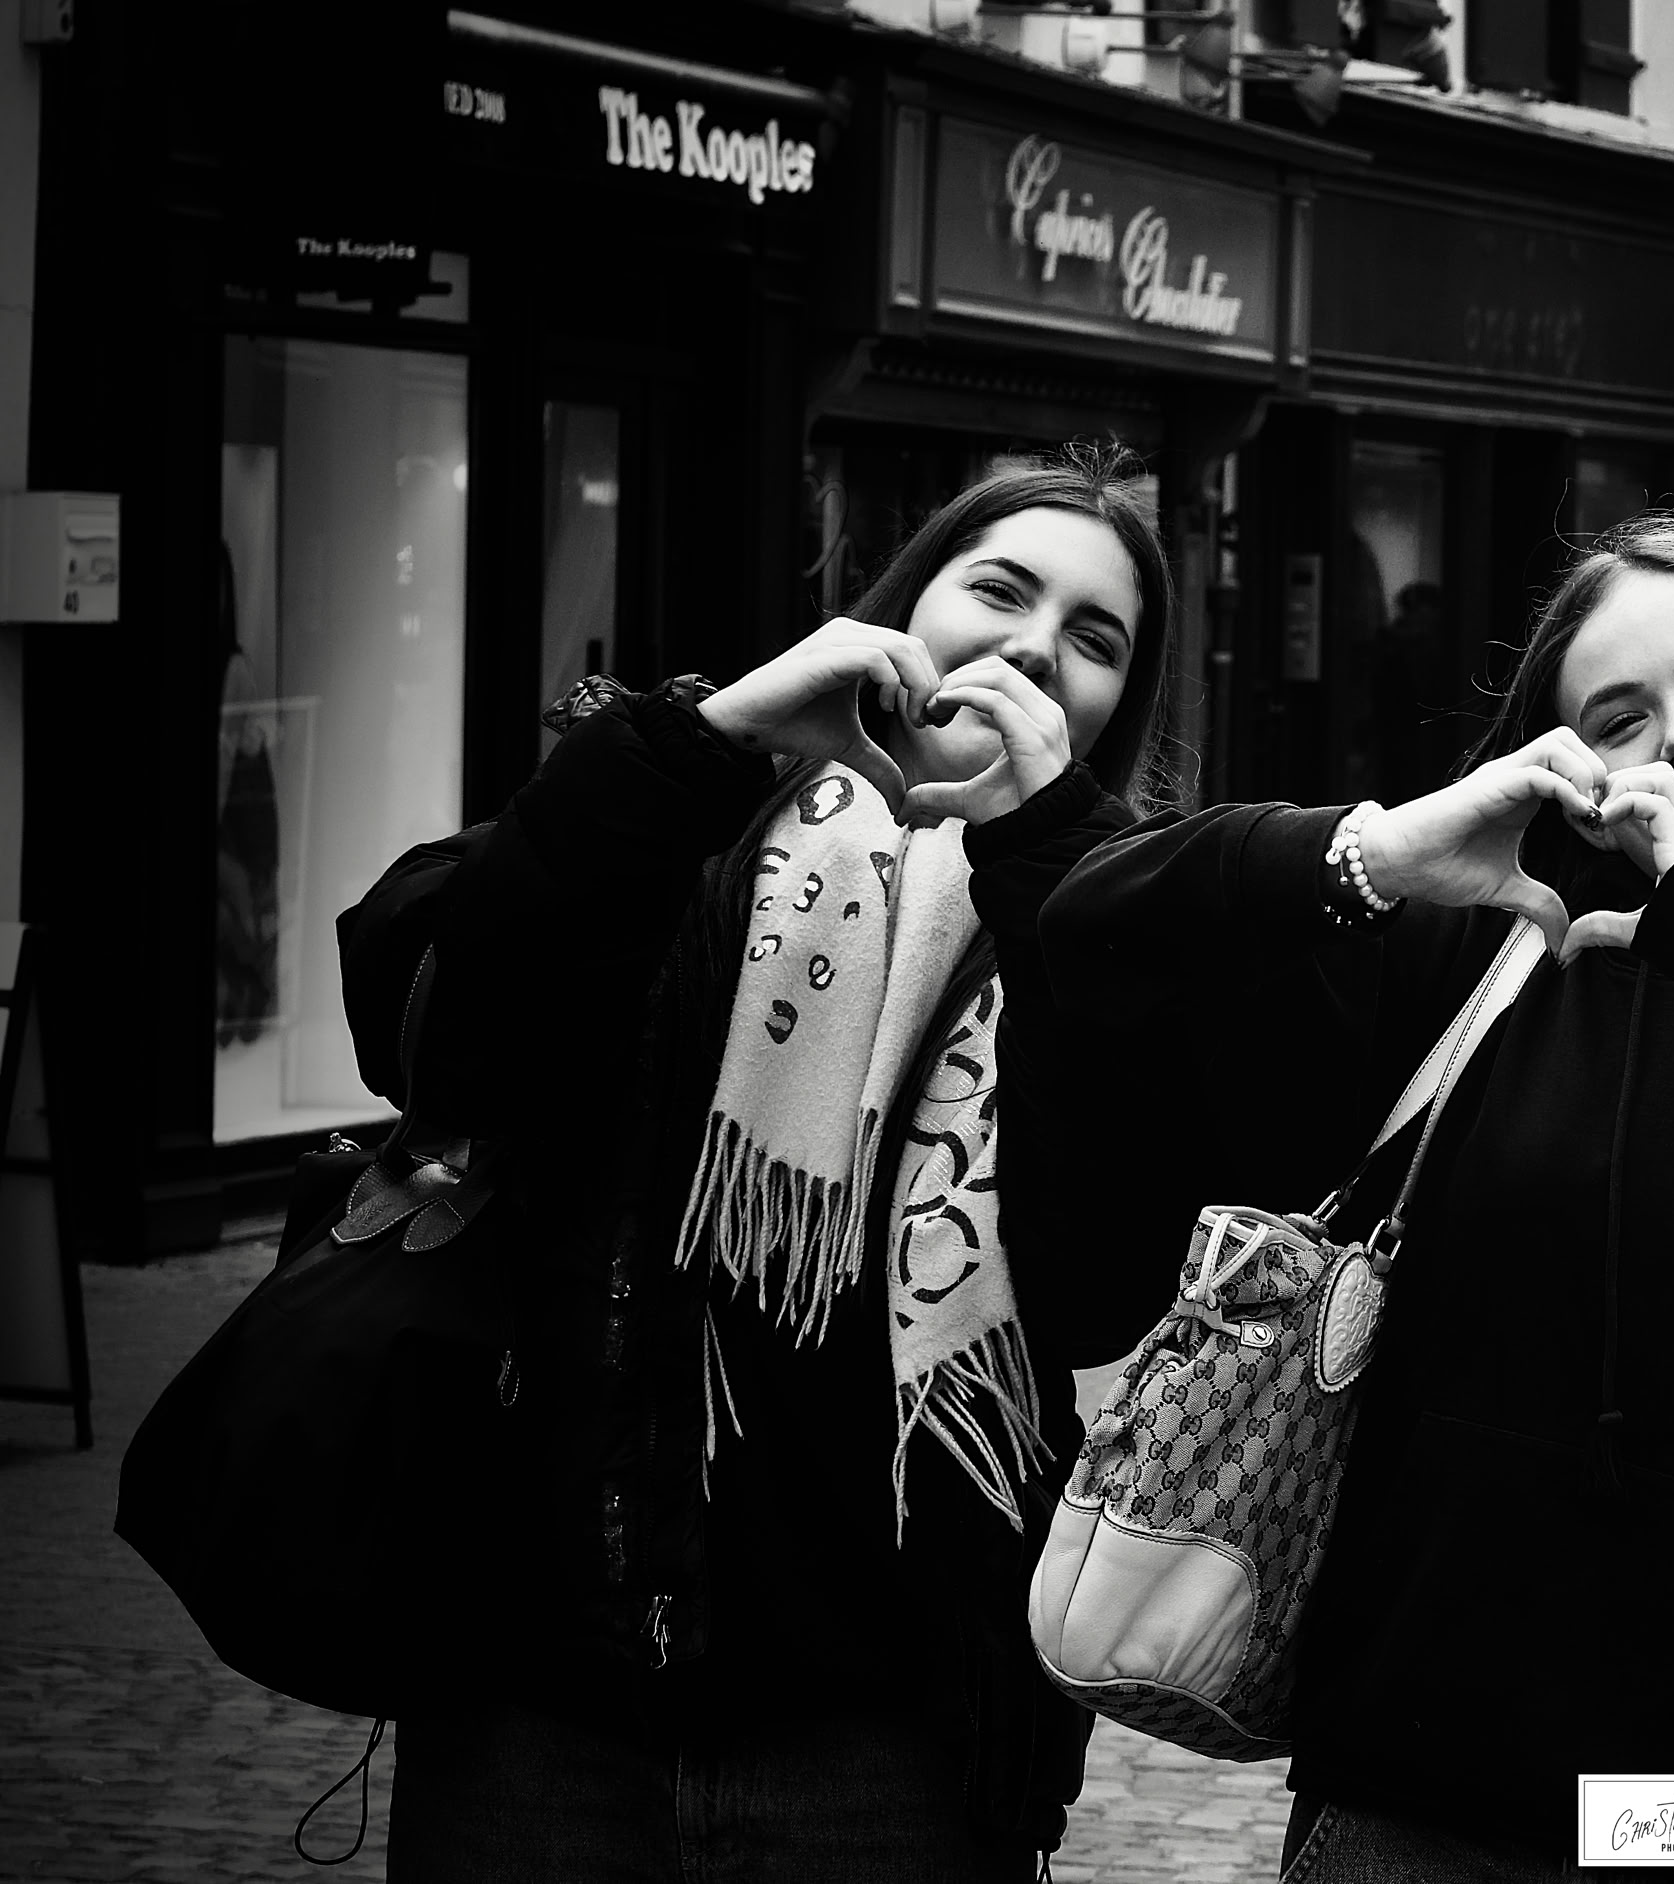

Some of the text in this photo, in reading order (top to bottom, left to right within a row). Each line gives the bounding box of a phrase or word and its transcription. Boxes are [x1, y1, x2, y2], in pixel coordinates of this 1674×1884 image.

[599, 86, 815, 205] The Kooples
[296, 237, 417, 262] The Kooples
